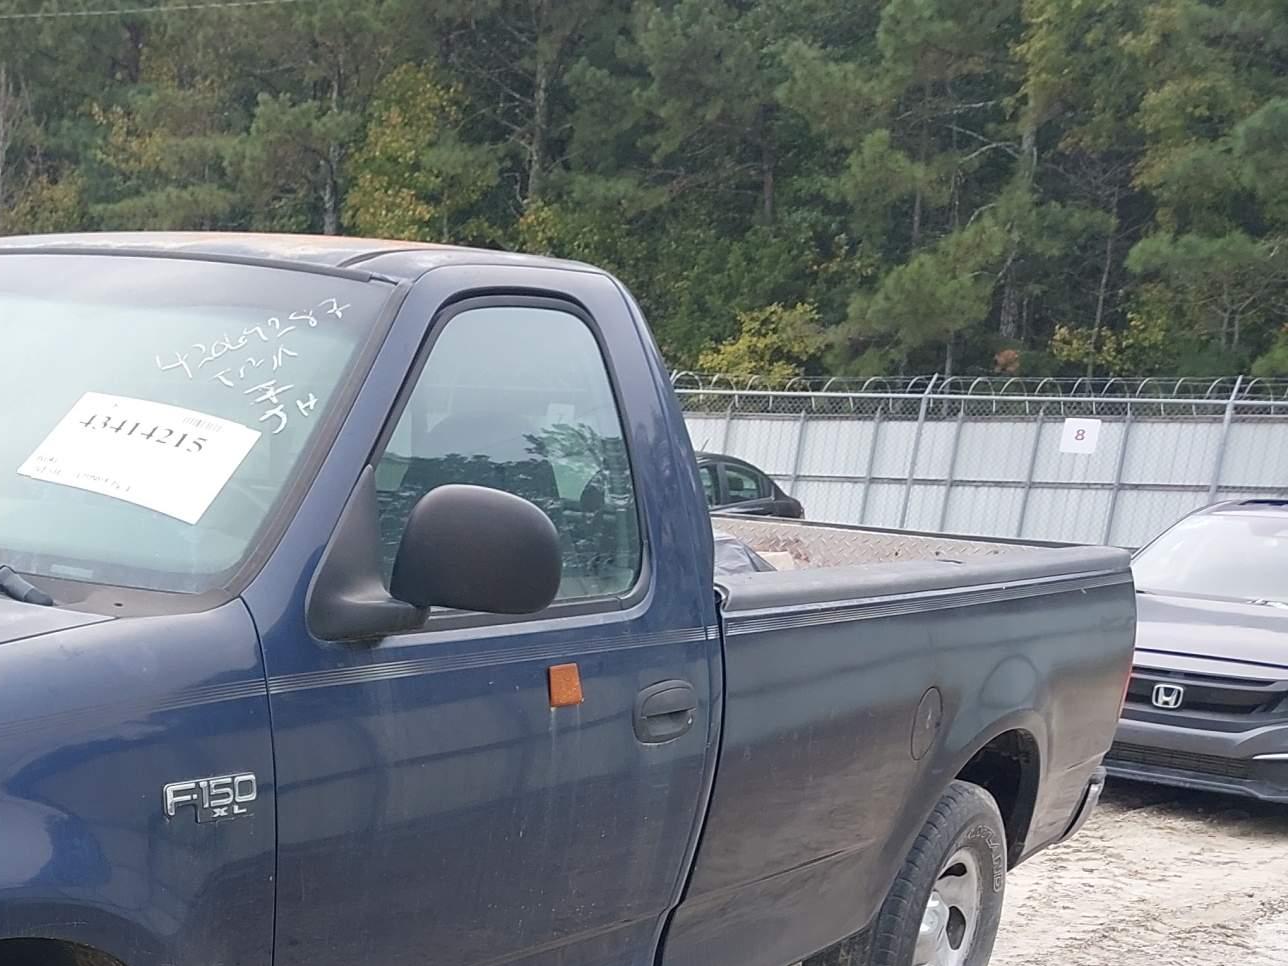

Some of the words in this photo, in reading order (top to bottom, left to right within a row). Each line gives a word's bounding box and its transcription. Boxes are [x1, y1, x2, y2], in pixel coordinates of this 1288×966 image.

[79, 413, 208, 453] 43414215
[1074, 428, 1086, 441] 8
[212, 804, 247, 818] XL
